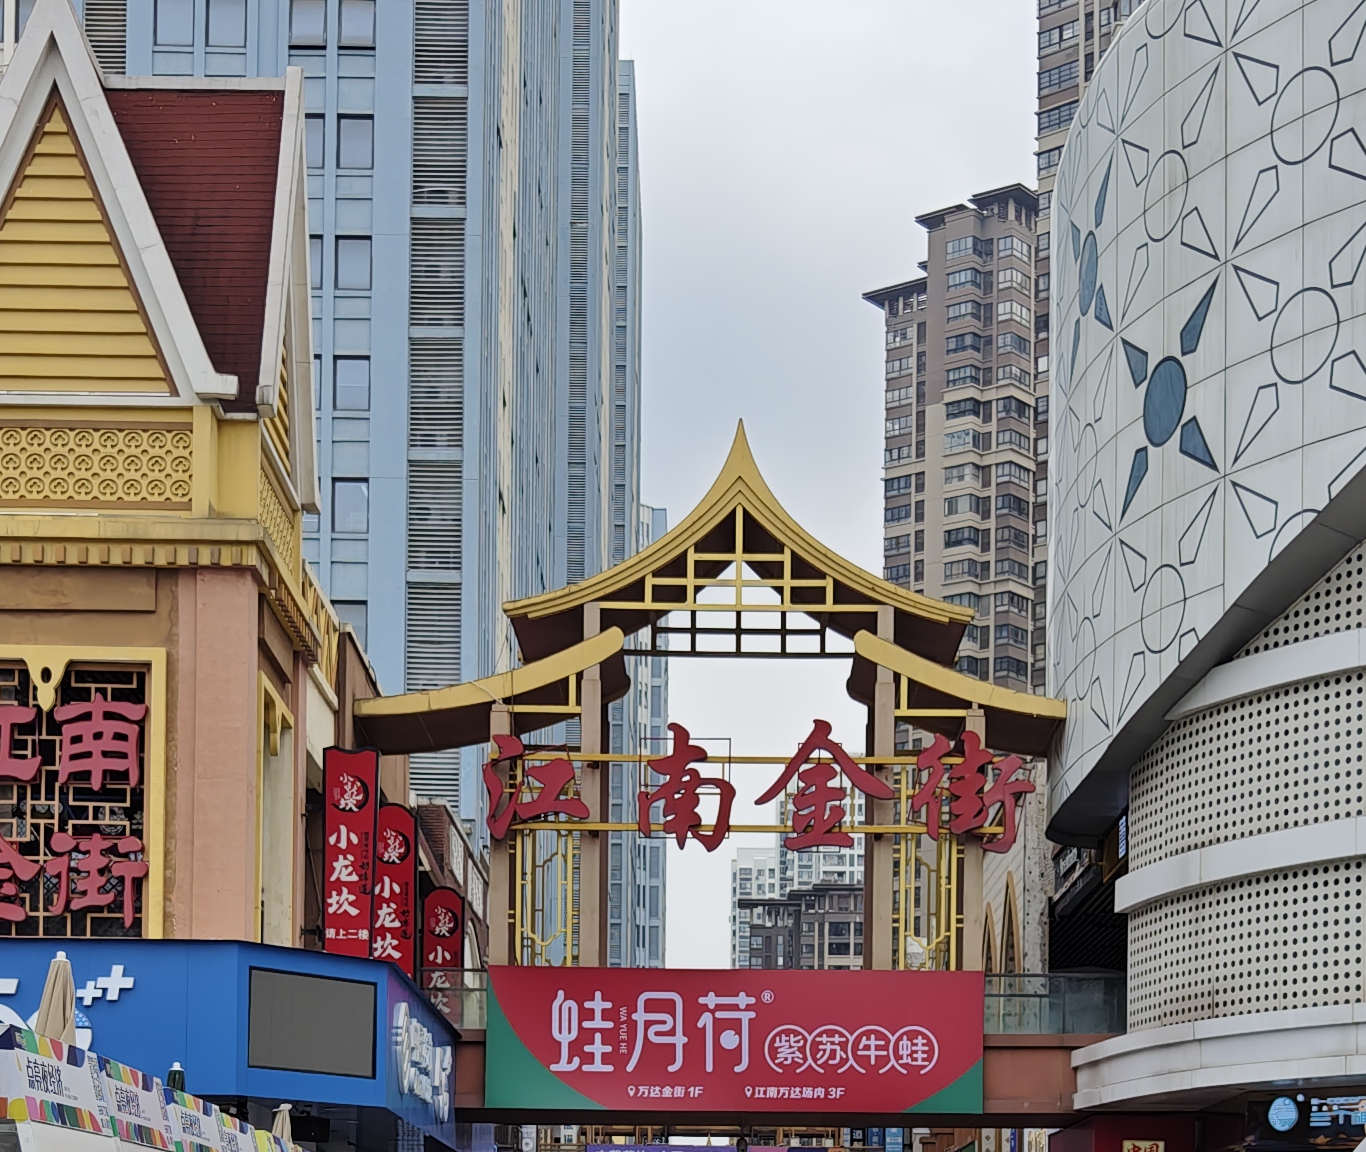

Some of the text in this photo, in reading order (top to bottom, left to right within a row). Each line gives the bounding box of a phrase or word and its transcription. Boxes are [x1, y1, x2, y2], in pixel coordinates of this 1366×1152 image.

[483, 719, 1036, 853] 江南金街
[326, 825, 360, 916] 小龙坎
[325, 928, 370, 940] 请上二楼
[373, 876, 403, 960] 小龙坎
[771, 1032, 933, 1068] 紫苏牛蛙
[637, 1086, 704, 1098] 万达金街 1F
[754, 1086, 846, 1099] 江南万达场内 3F
